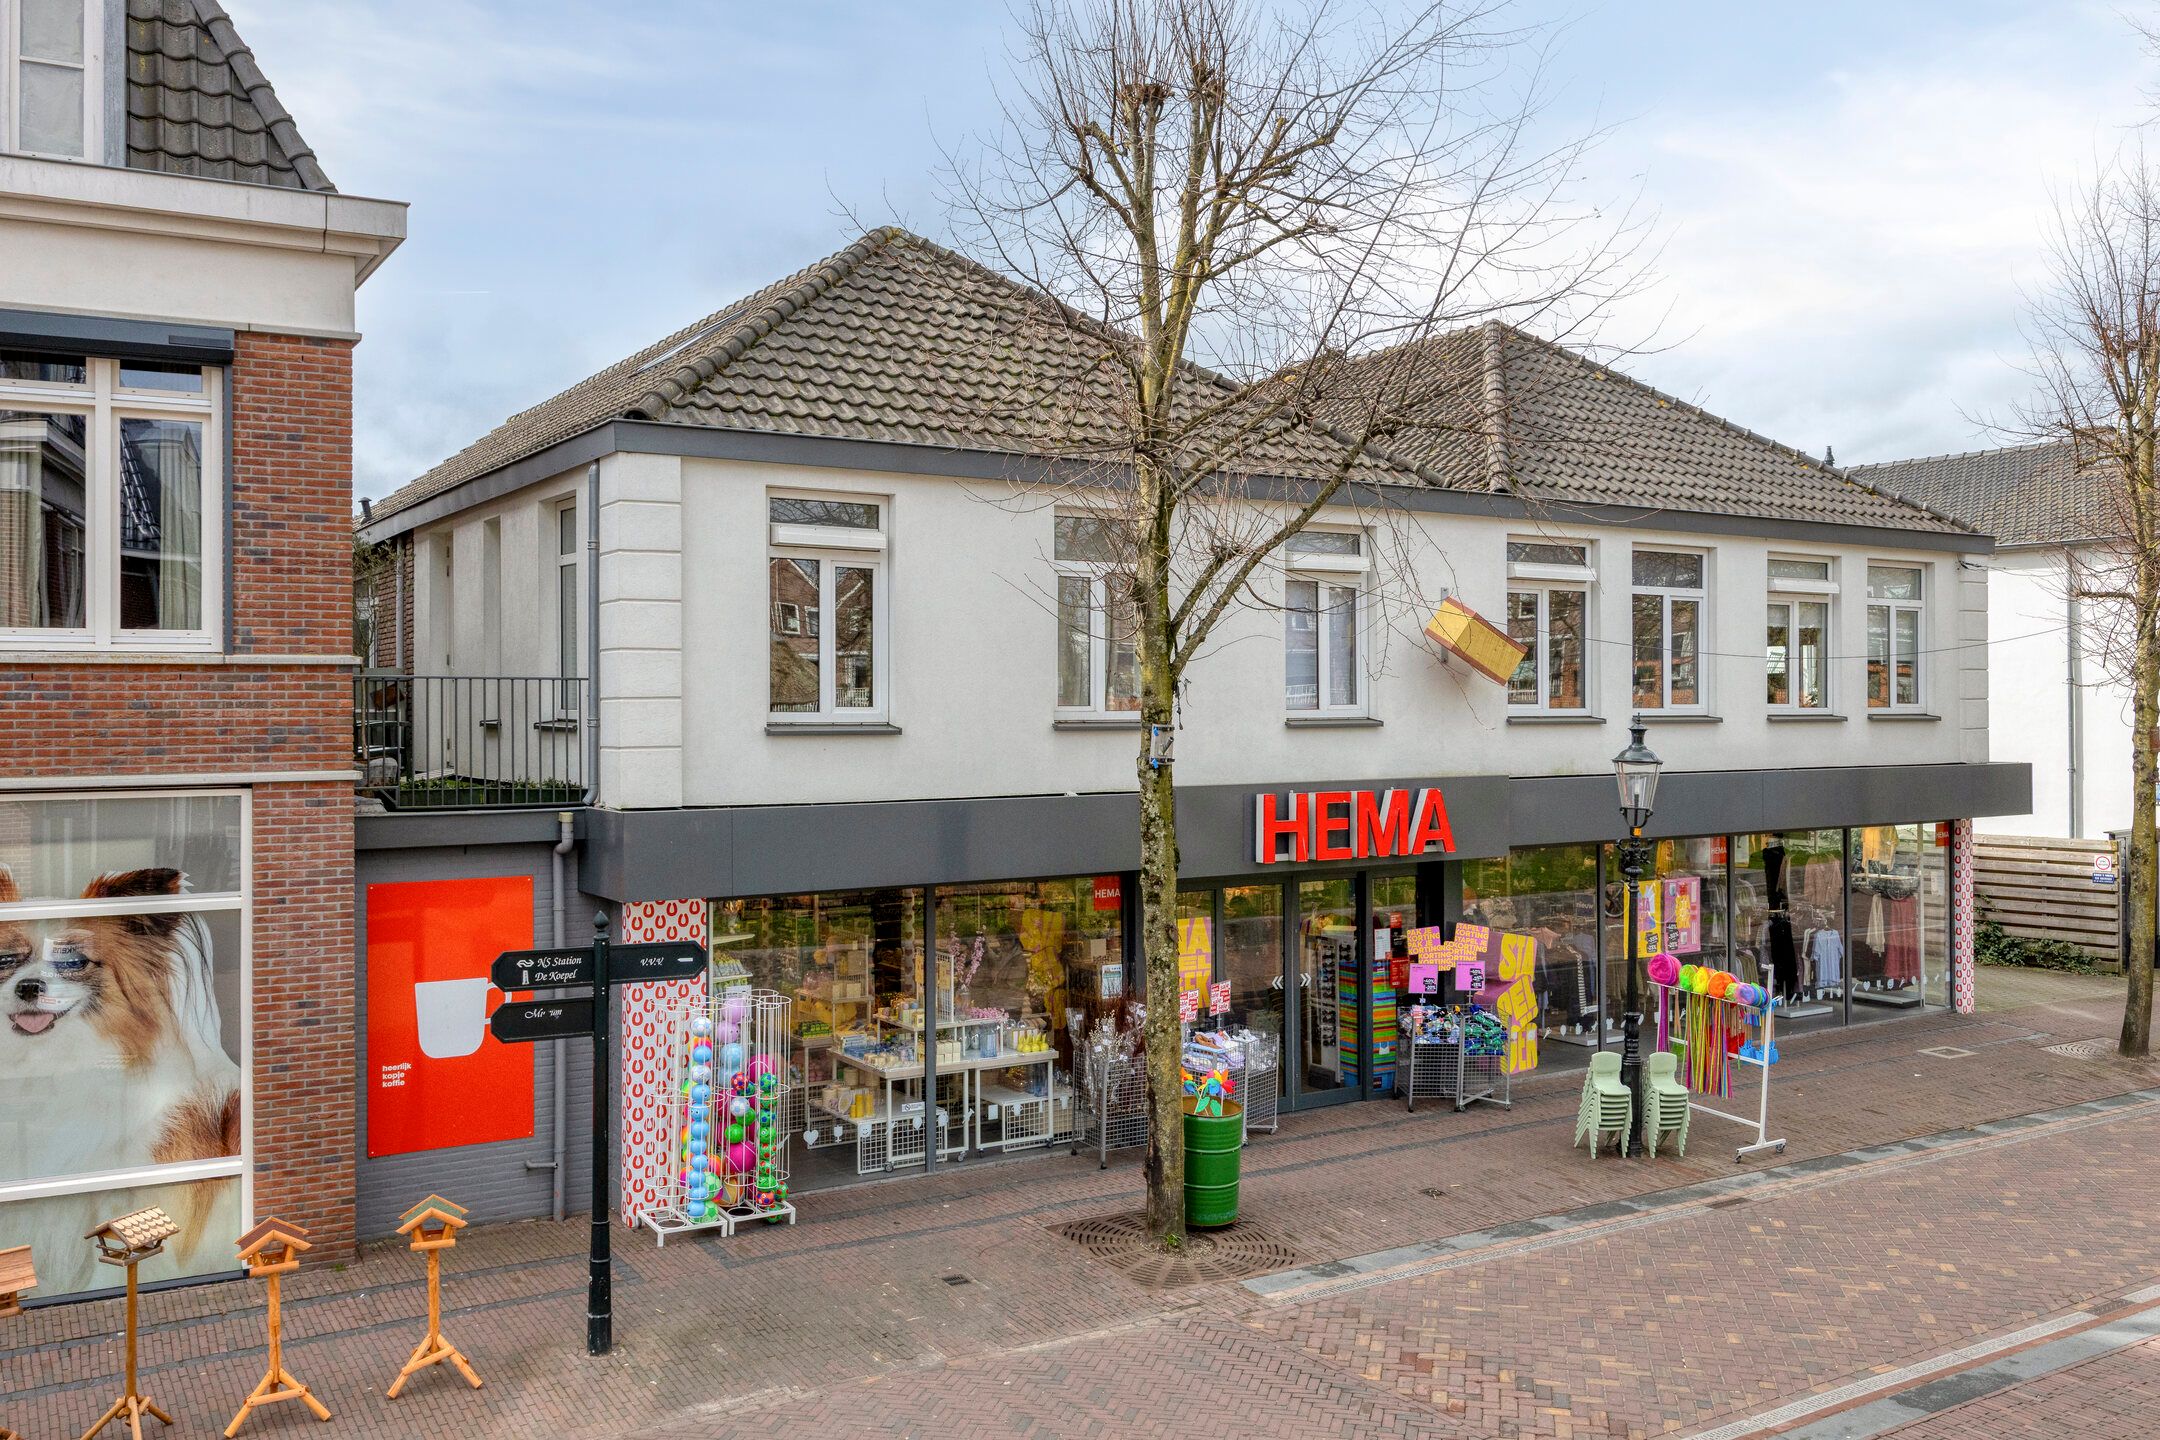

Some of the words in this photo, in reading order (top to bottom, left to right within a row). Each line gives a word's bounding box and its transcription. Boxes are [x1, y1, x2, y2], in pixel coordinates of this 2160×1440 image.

[1256, 788, 1456, 864] HEMA
[1094, 888, 1121, 898] HEMA
[1178, 917, 1211, 954] TA
[1407, 928, 1421, 936] PAK
[1407, 932, 1440, 942] KORTING
[1455, 929, 1488, 939] KORTING
[537, 956, 551, 968] NS
[552, 955, 582, 967] Station
[535, 971, 547, 981] De
[549, 969, 578, 982] Koepel
[382, 1062, 412, 1072] heerlijk
[382, 1071, 405, 1080] kopje
[382, 1079, 405, 1088] koffie
